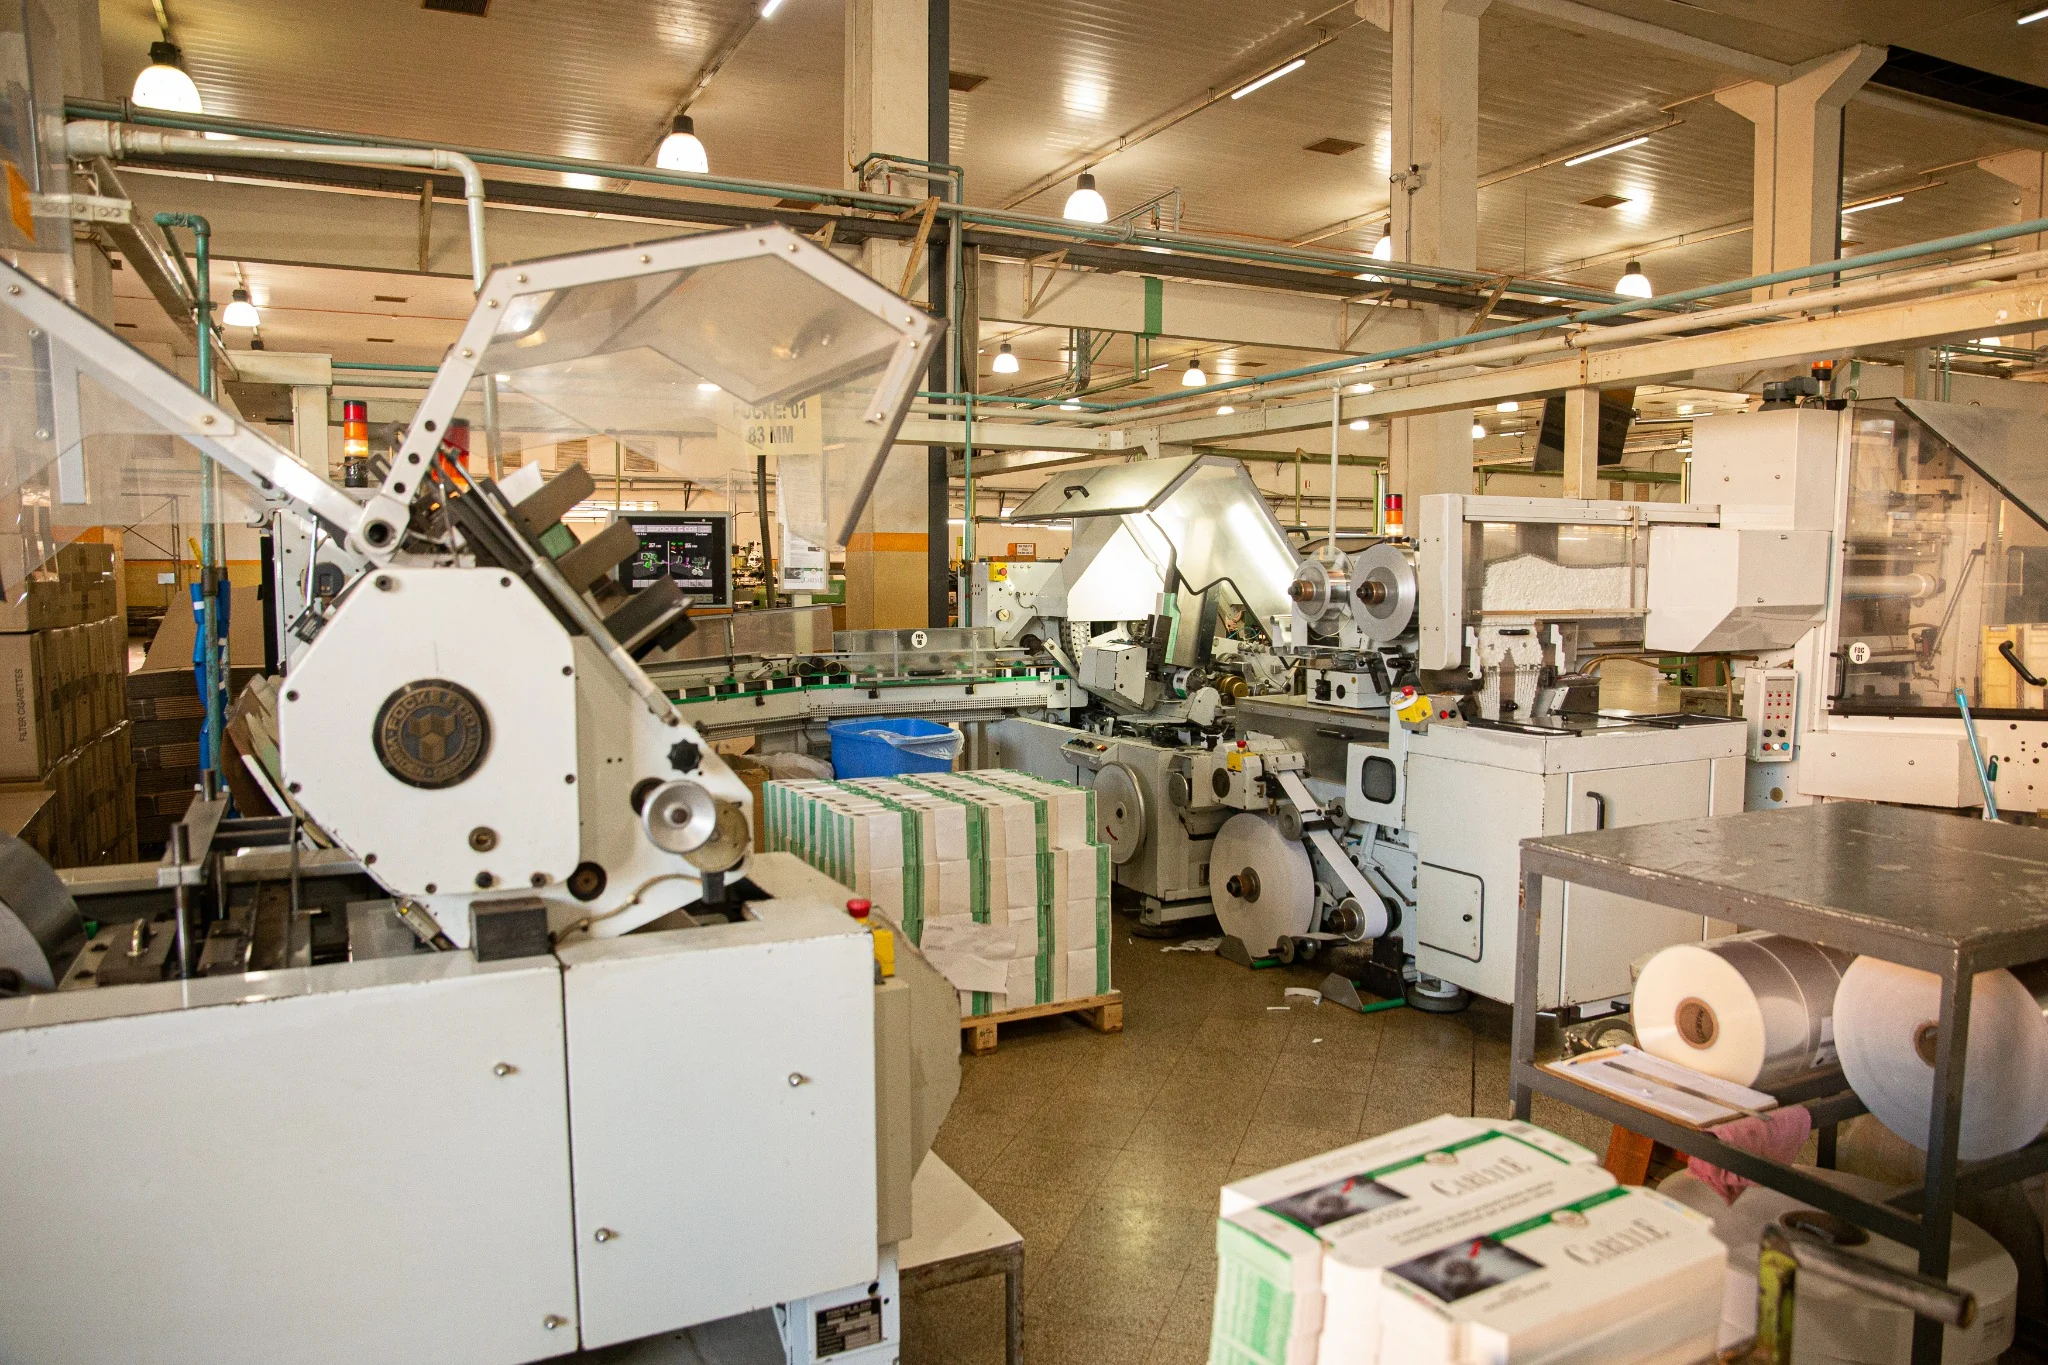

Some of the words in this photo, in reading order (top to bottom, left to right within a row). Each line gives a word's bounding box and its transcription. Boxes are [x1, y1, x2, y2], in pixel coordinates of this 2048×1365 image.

[791, 400, 806, 419] 01
[748, 426, 765, 444] 83
[770, 426, 794, 444] MM
[1854, 646, 1865, 654] FOC
[1856, 654, 1863, 662] 01
[14, 668, 26, 715] CIGARETTES
[18, 719, 28, 742] FILTER
